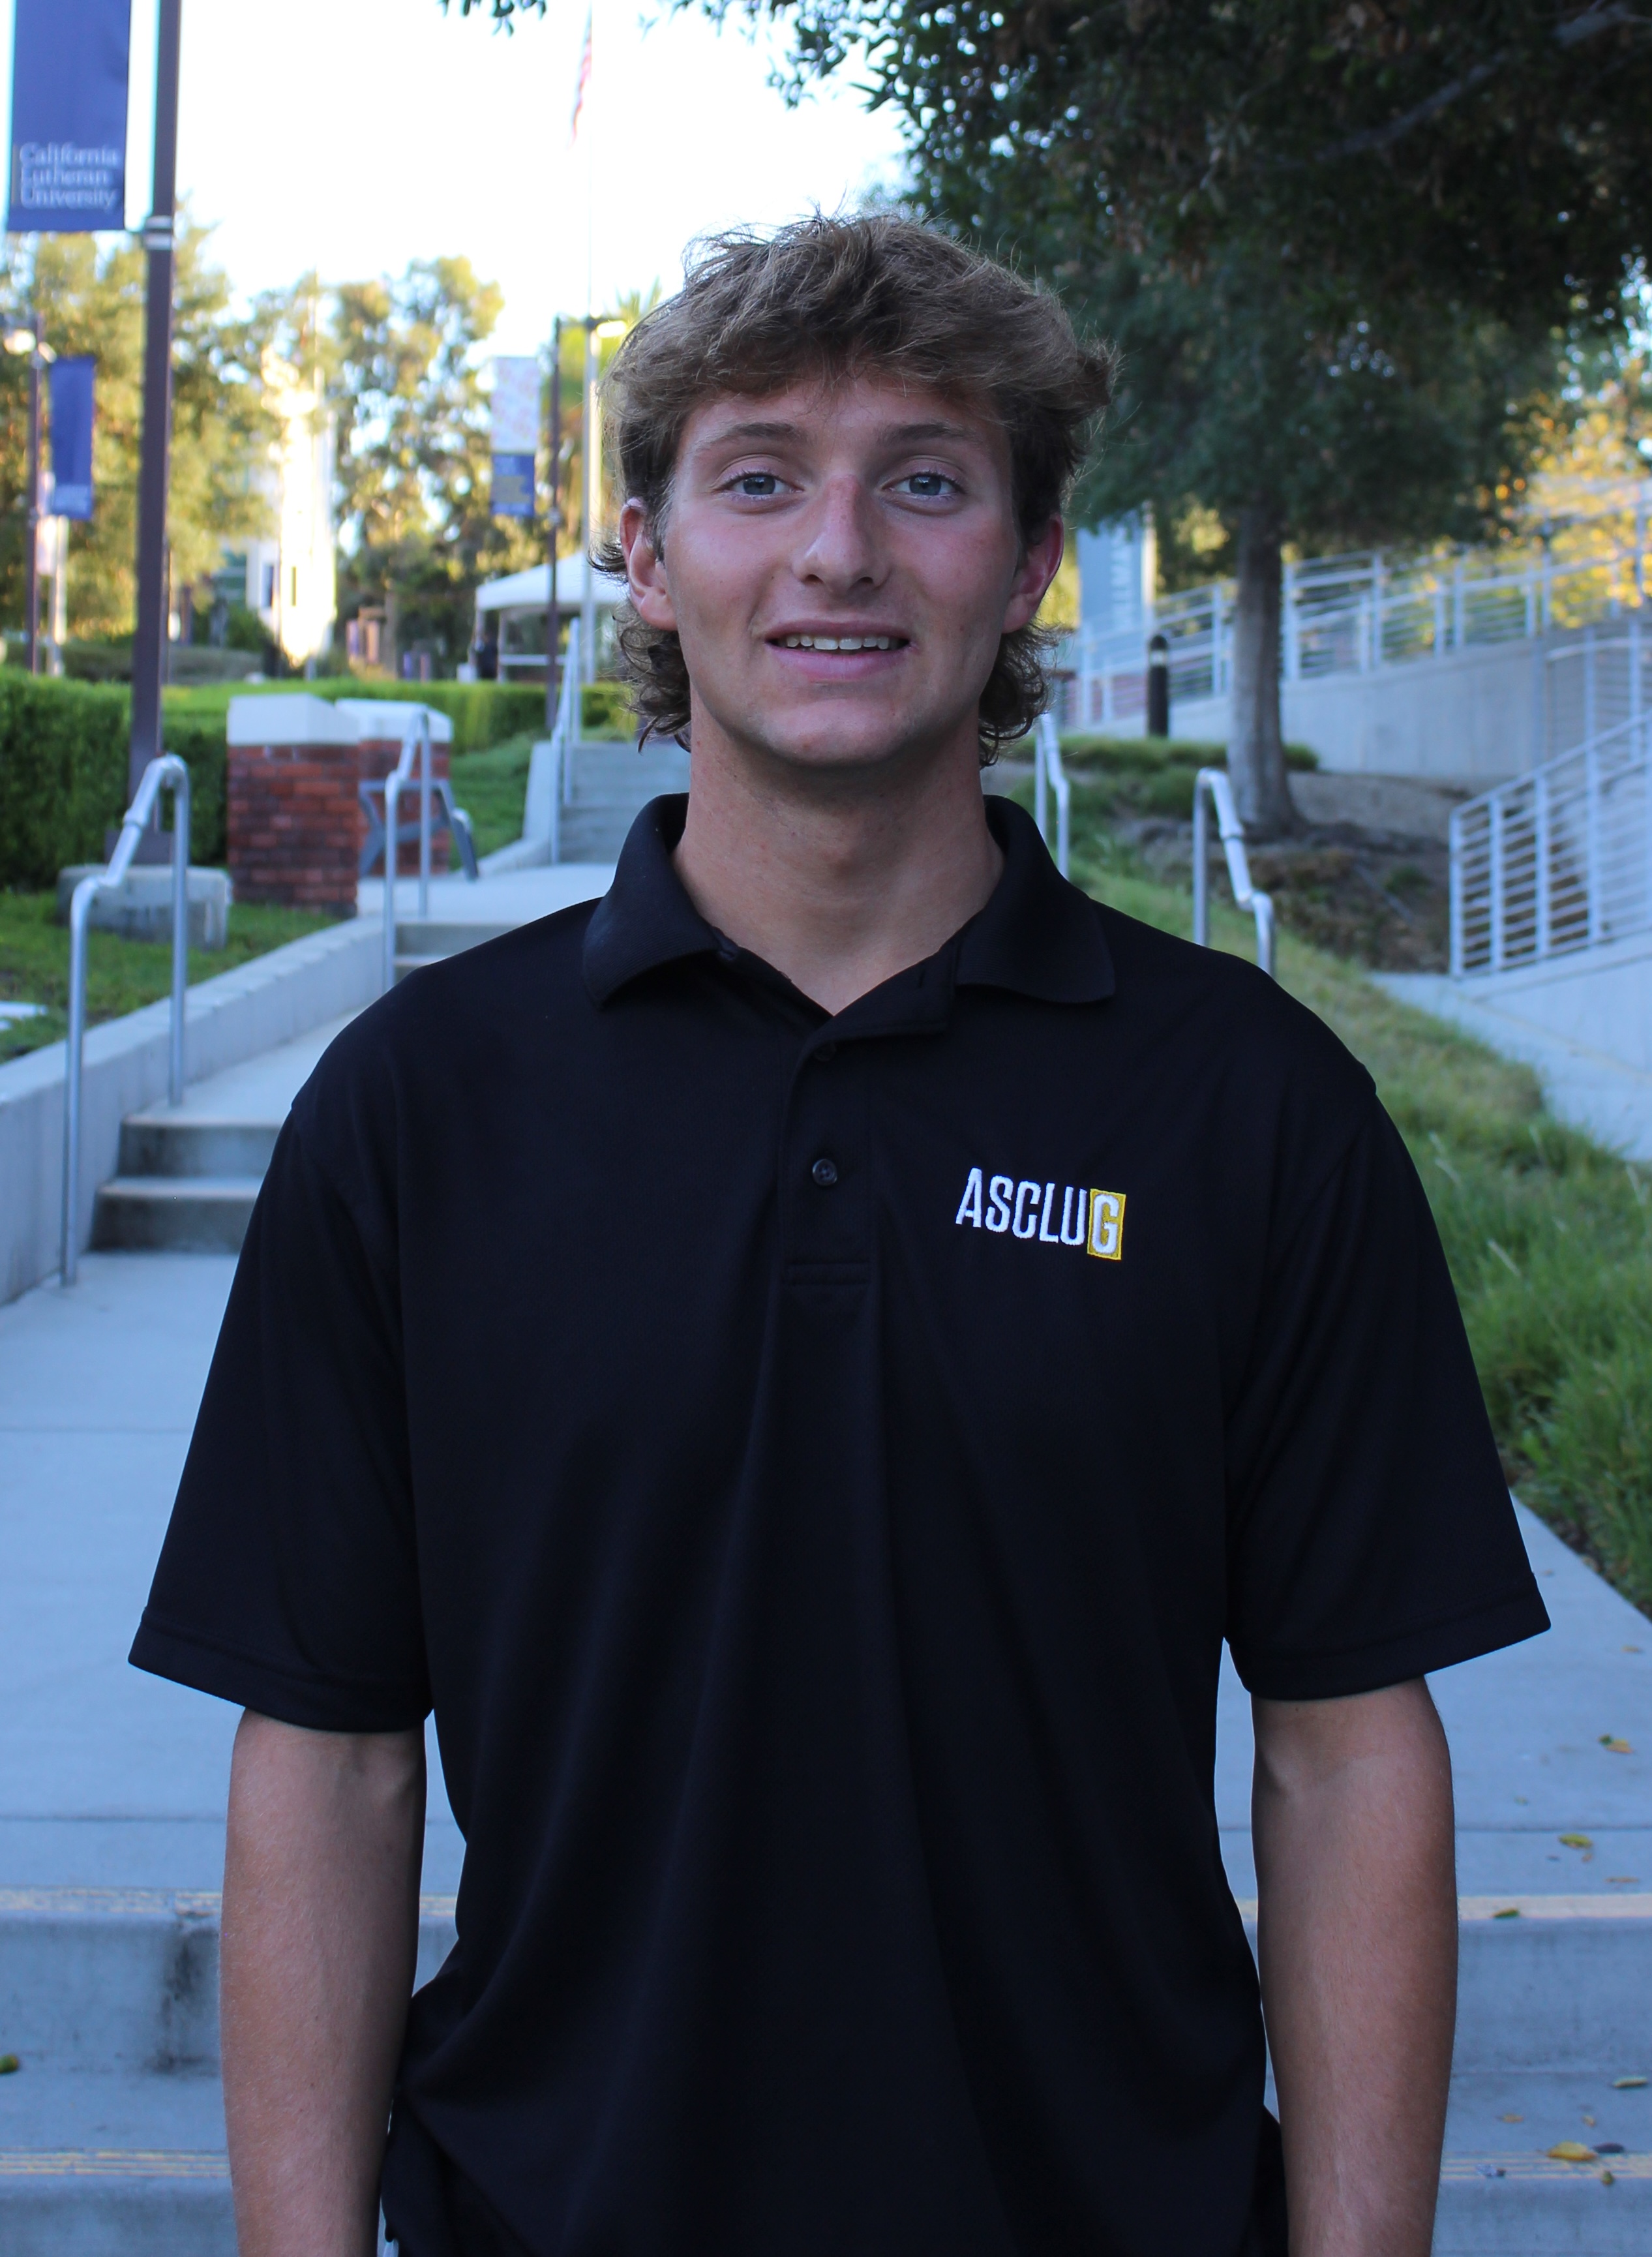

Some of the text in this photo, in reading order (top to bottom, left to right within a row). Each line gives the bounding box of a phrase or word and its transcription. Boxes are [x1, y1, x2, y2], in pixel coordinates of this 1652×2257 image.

[21, 142, 120, 165] California
[22, 164, 112, 186] Lutheran
[22, 187, 117, 213] University
